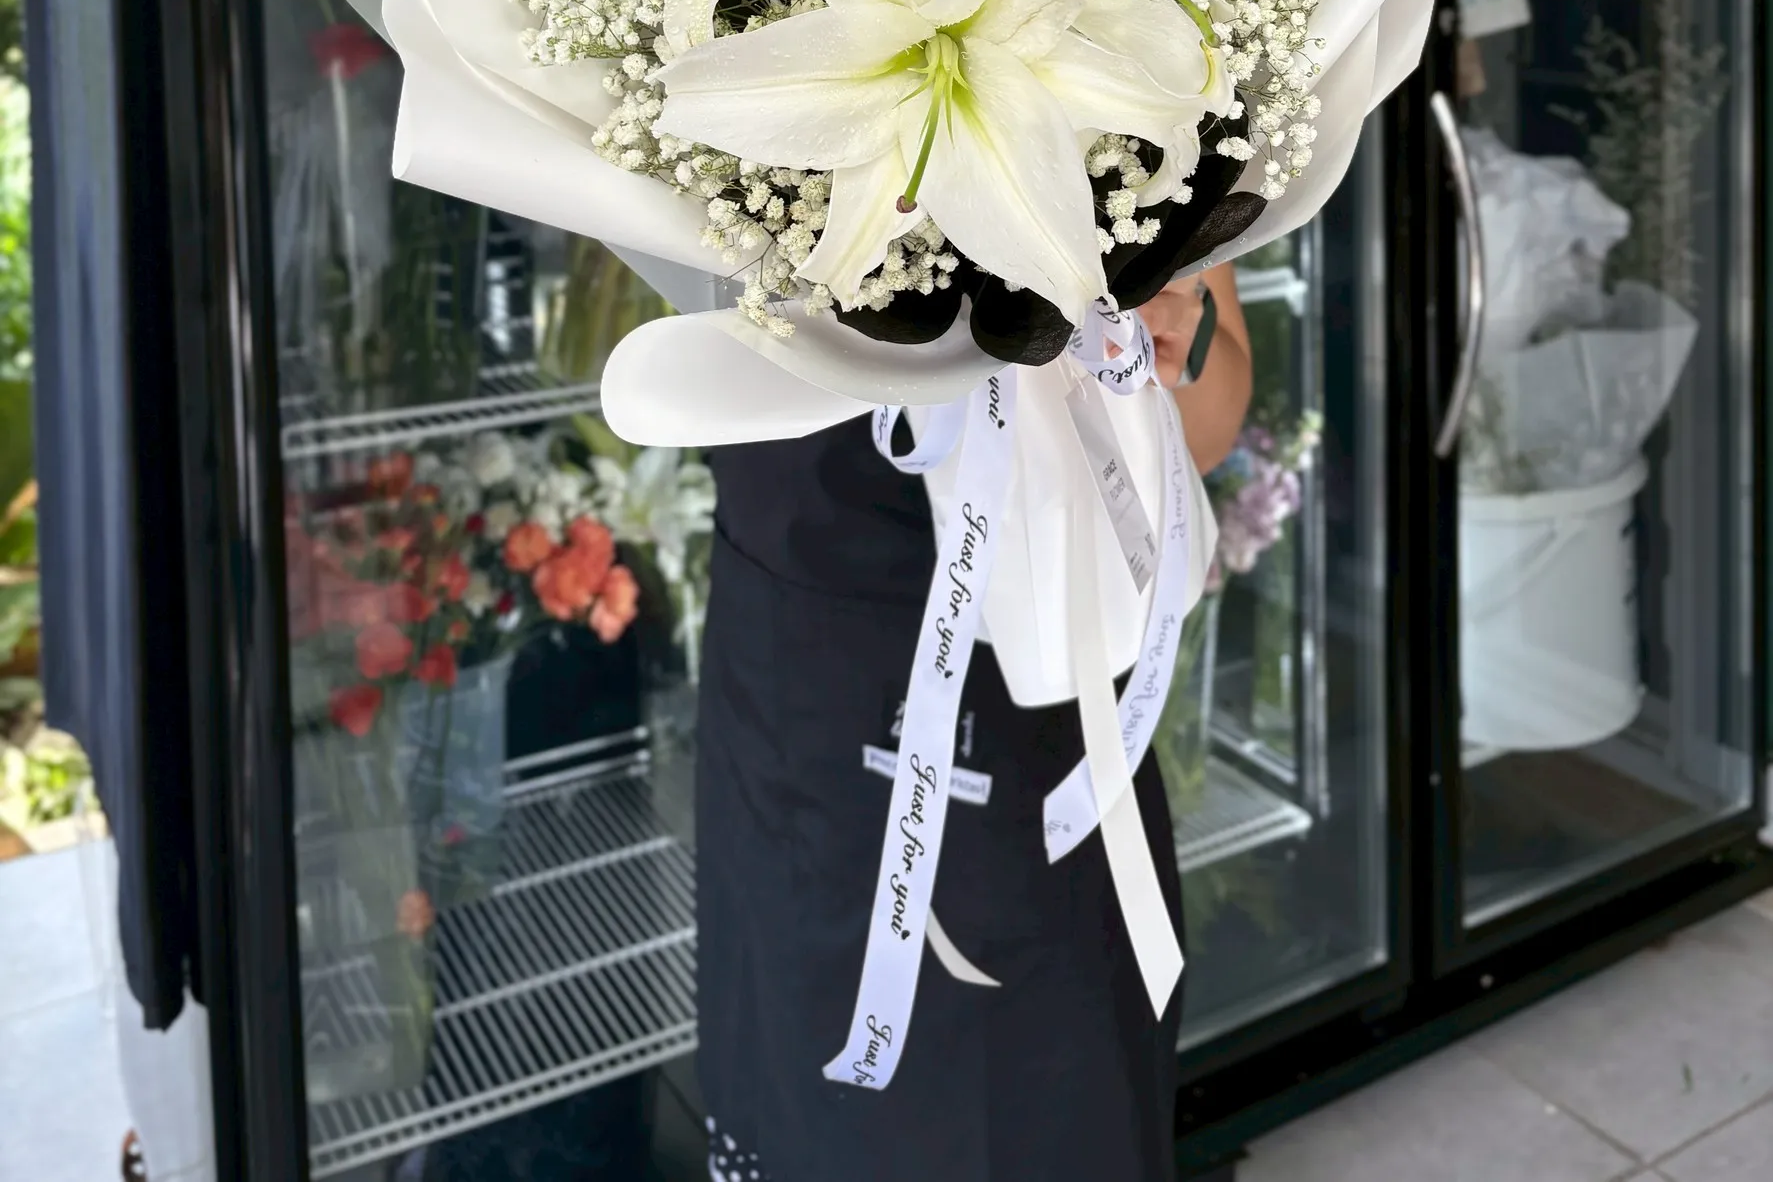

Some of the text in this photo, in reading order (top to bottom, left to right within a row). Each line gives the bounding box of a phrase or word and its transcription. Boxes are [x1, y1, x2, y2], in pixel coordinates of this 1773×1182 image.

[935, 502, 988, 674] Just for you
[890, 753, 937, 935] Just for you
[863, 1014, 892, 1068] Just
